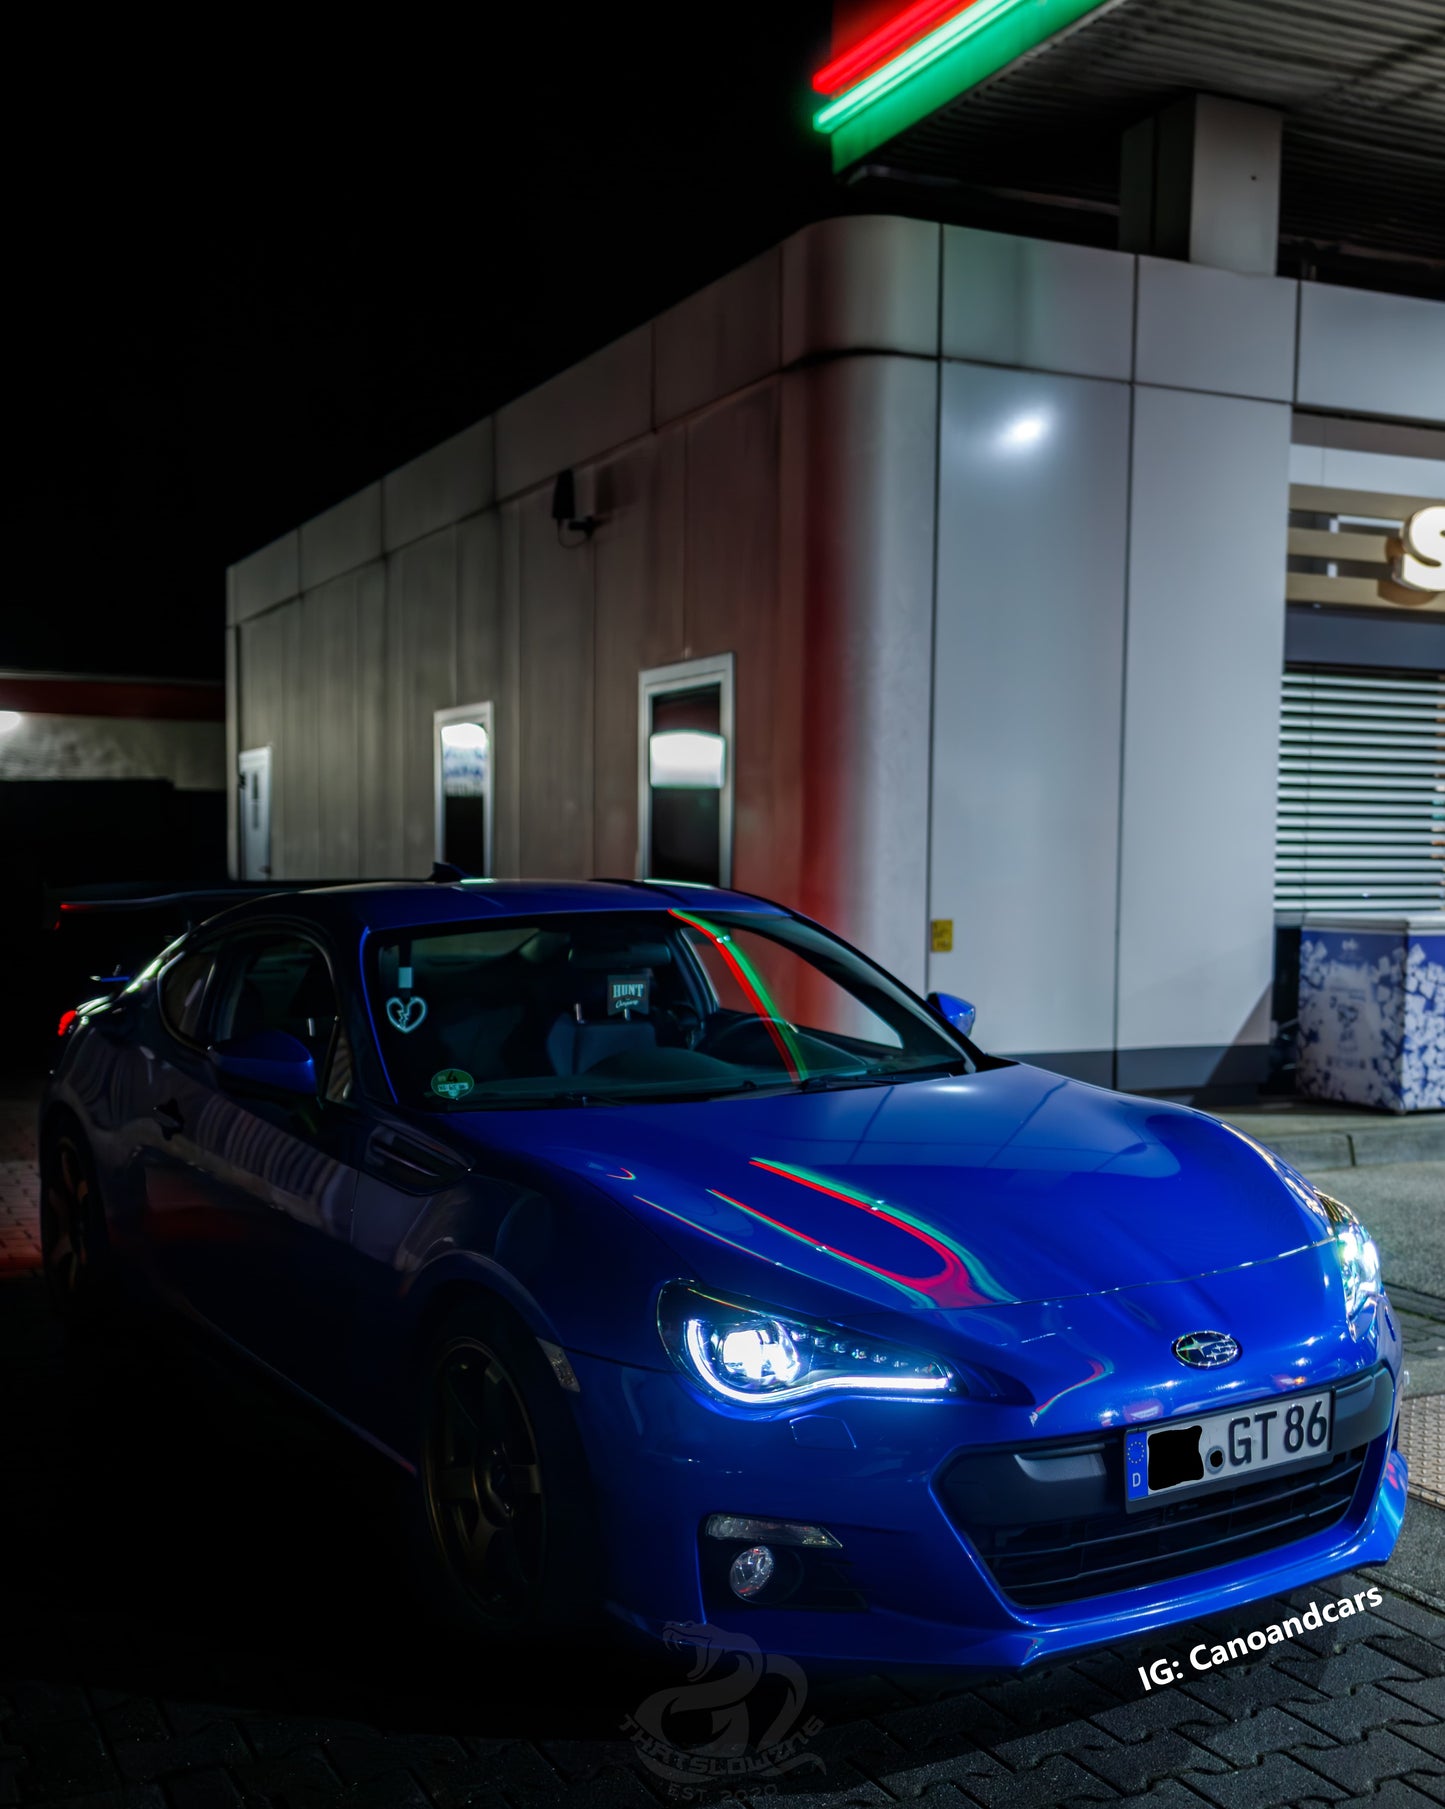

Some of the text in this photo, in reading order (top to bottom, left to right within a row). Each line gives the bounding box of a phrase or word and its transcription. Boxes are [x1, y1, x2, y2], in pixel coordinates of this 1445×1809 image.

[612, 983, 644, 999] HUNT
[1132, 1400, 1328, 1487] D GT 86
